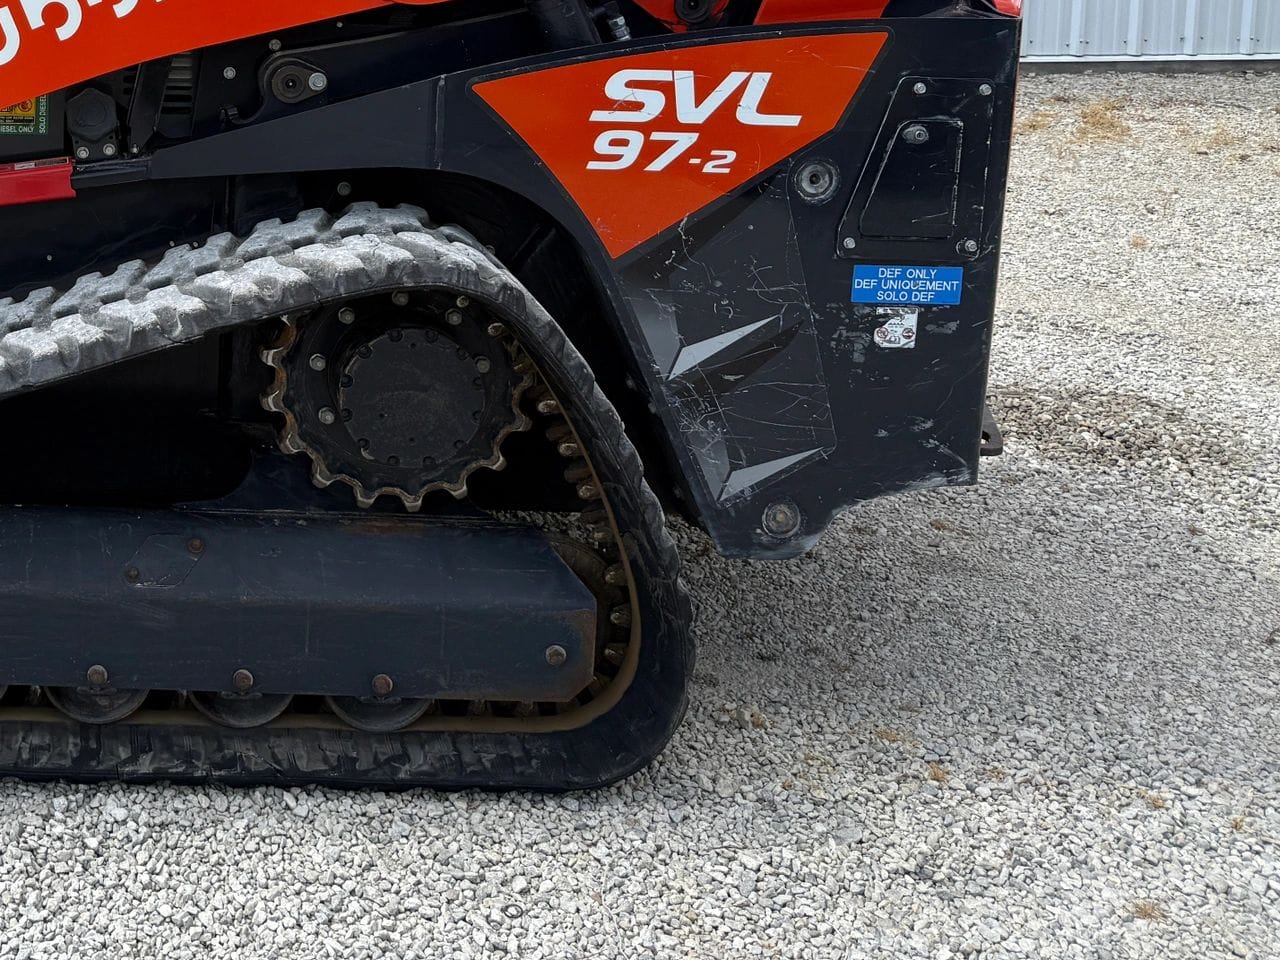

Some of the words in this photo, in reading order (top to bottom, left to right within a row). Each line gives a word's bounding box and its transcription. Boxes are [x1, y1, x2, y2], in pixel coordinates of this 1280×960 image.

[589, 69, 802, 127] SVL
[39, 95, 47, 116] DIESEL
[18, 125, 34, 133] ONLY
[585, 130, 737, 173] 97-2
[878, 268, 902, 278] DEF
[906, 269, 937, 279] ONLY
[854, 279, 878, 289] DEF
[881, 280, 959, 291] UNIQUEMENT
[876, 291, 908, 301] SOLO
[911, 292, 935, 302] DEF
